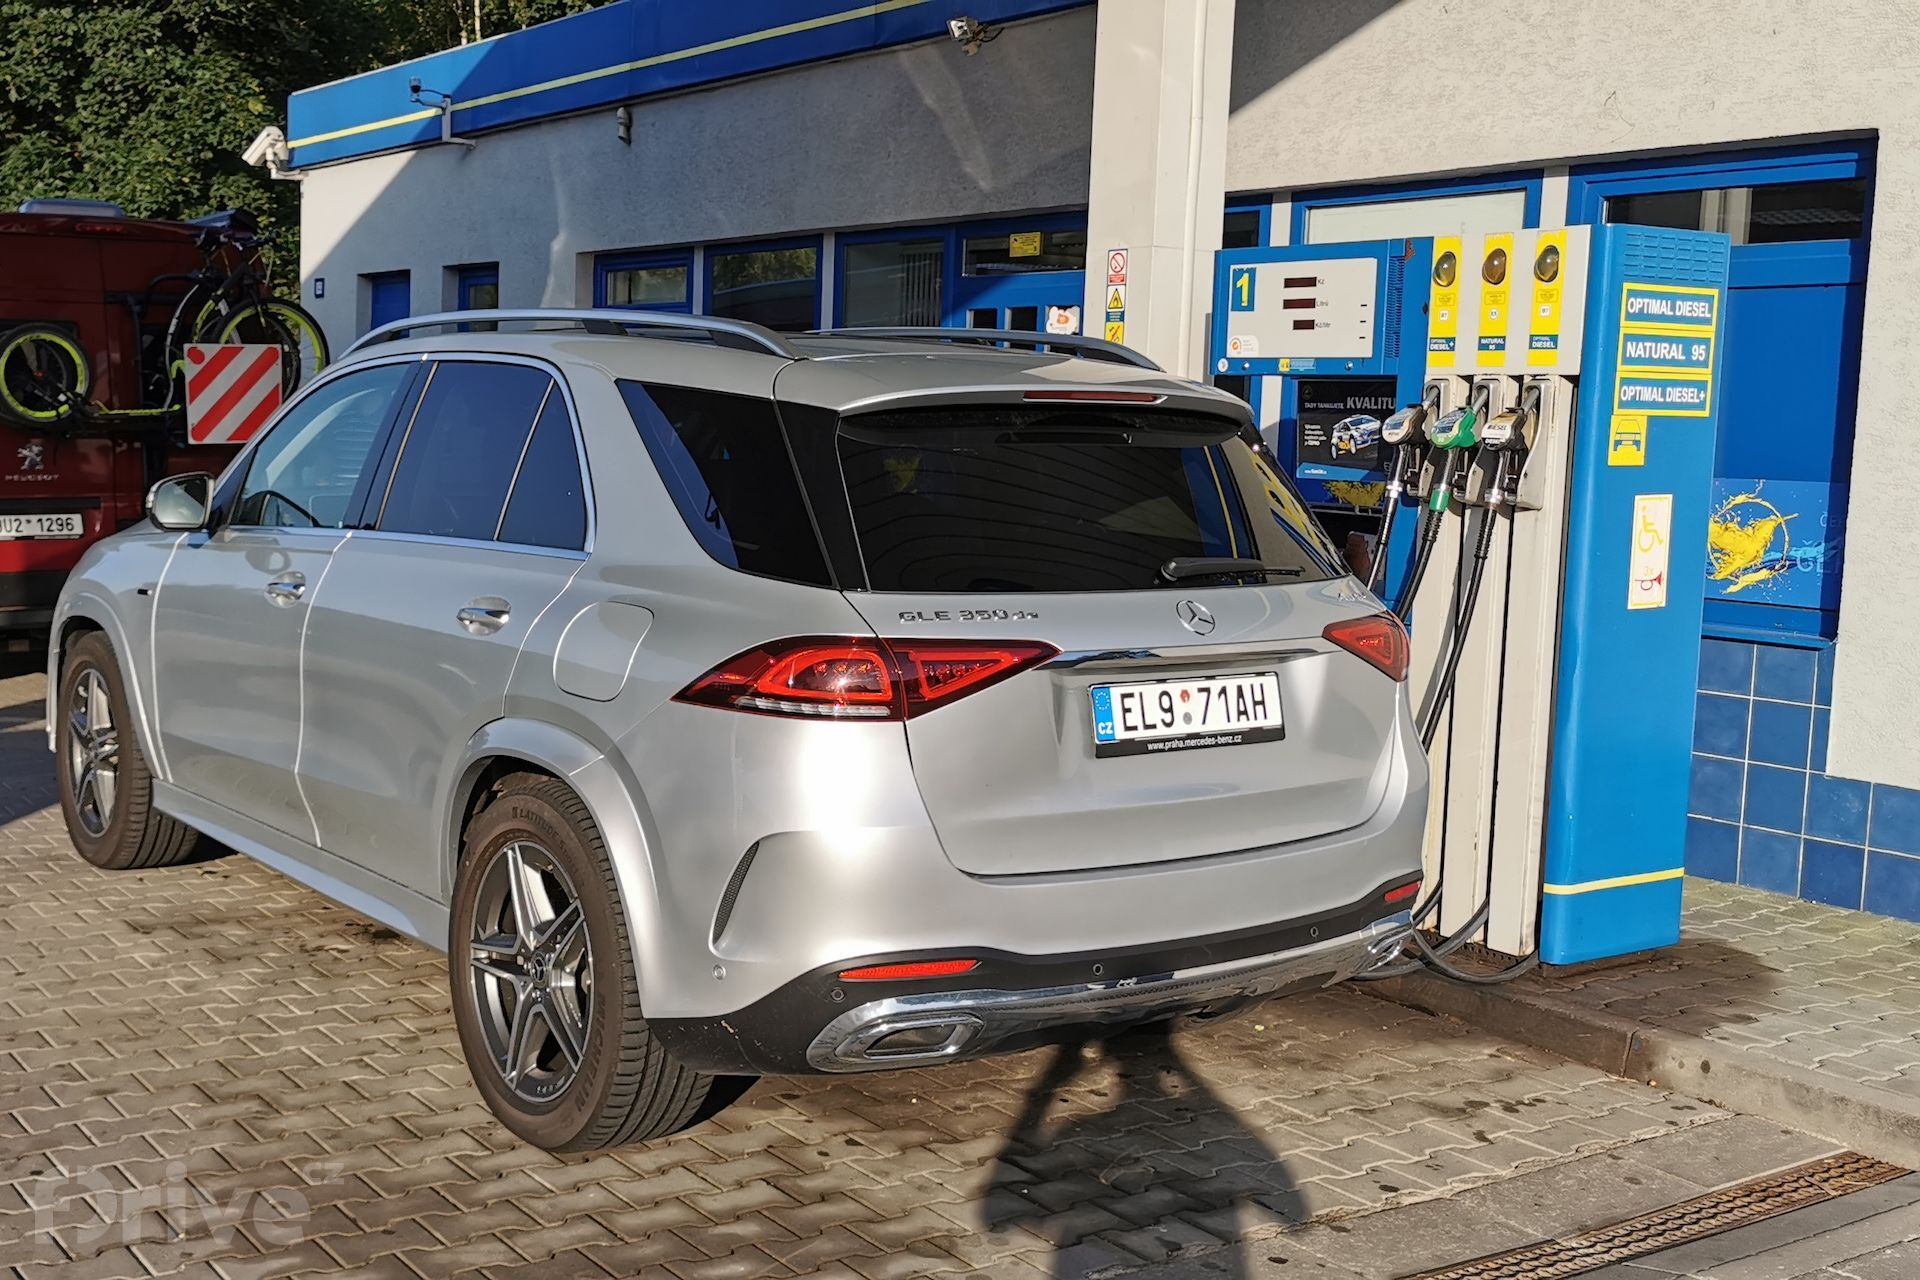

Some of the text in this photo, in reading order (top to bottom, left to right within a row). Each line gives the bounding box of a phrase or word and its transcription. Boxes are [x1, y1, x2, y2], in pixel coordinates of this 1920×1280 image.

[1236, 272, 1249, 306] 1
[1627, 297, 1711, 318] OPTIMAL DIESEL
[1480, 337, 1505, 345] NATURAL
[1531, 340, 1556, 348] DIESEL
[1626, 341, 1706, 360] NATURAL 95
[1620, 385, 1706, 403] OPTIMAL DIESEL+
[1346, 396, 1396, 410] KVALITU
[0, 517, 75, 533] U2 1296
[899, 610, 951, 623] GLE
[958, 609, 1008, 621] 350
[1120, 682, 1268, 732] EL9 71AH
[1098, 722, 1114, 735] CZ
[1147, 734, 1243, 751] www.praha.mercedes-benz.cz
[574, 992, 607, 1114] MICHELIN
